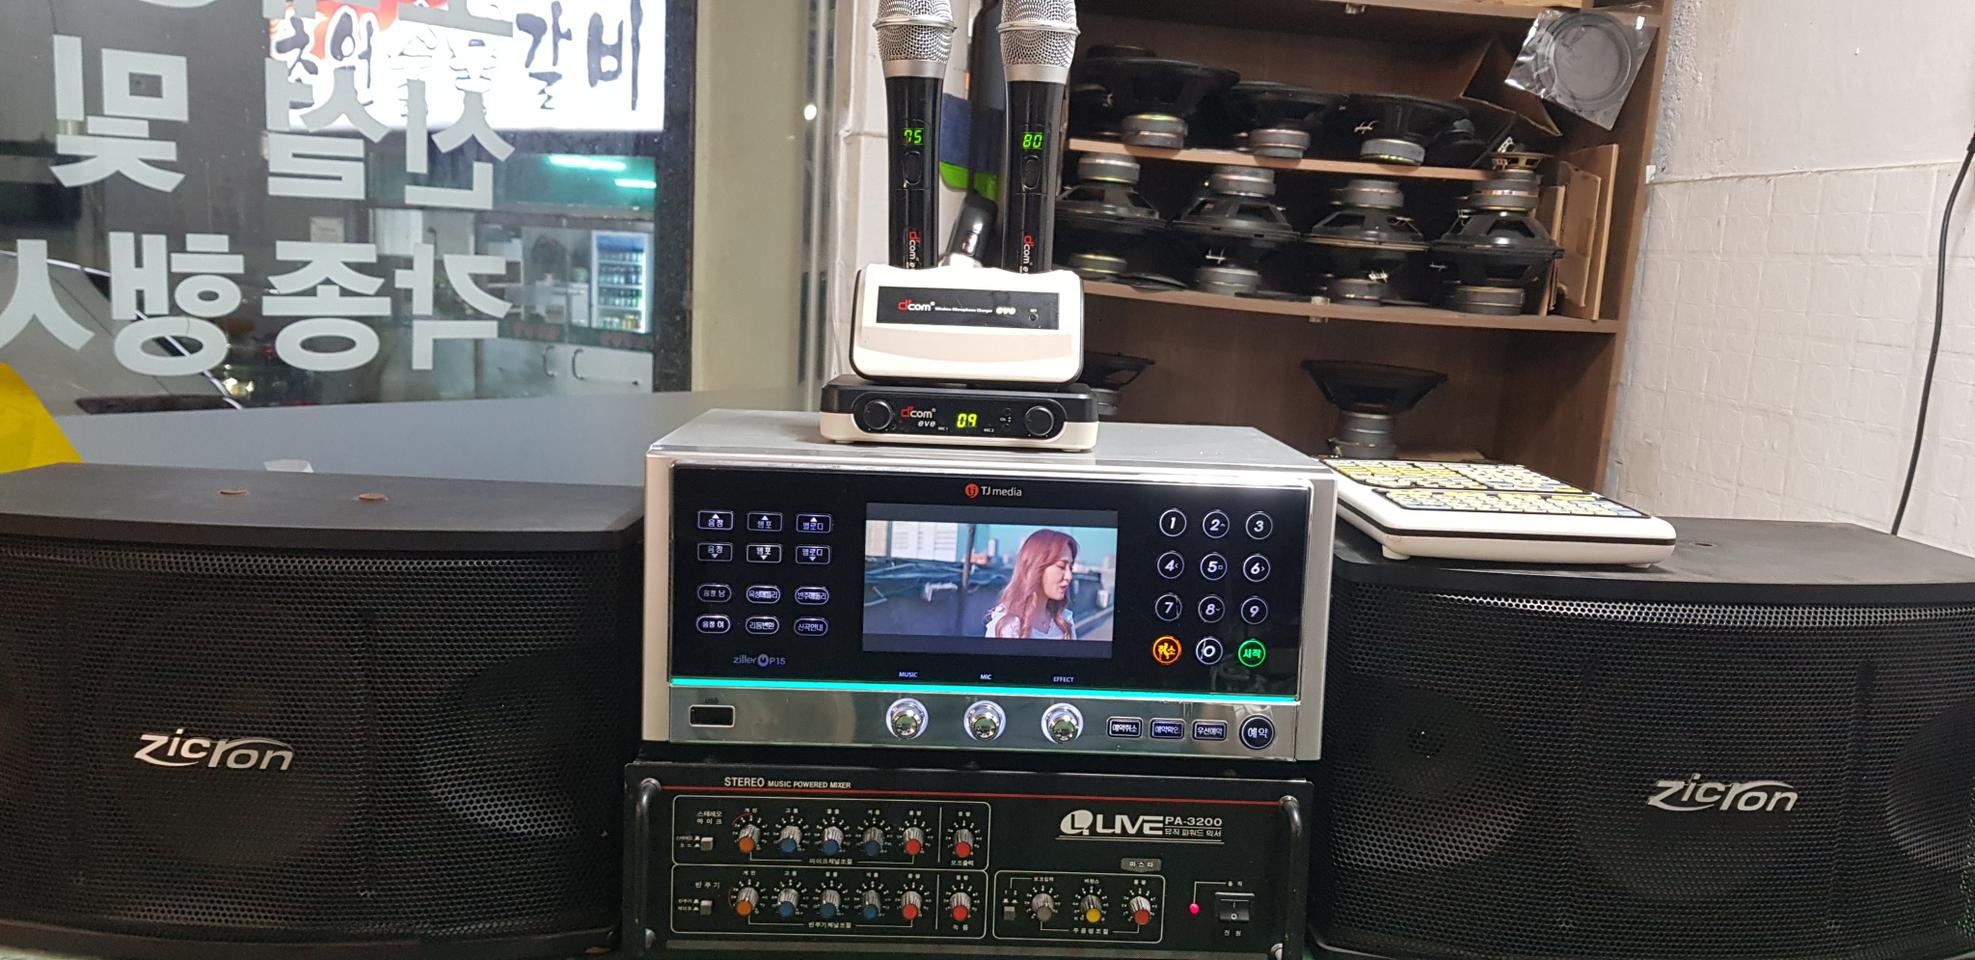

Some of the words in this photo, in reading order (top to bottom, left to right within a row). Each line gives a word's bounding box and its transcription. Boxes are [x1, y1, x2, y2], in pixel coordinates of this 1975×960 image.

[1022, 133, 1043, 148] 80
[956, 413, 978, 429] 09
[992, 486, 1022, 497] media
[1170, 516, 1177, 530] 1
[1209, 518, 1221, 531] 2
[1253, 520, 1264, 533] 3
[1164, 559, 1175, 572] 4
[1207, 560, 1218, 573] 5
[1250, 562, 1260, 575] 6
[1164, 601, 1174, 614] 7
[1204, 603, 1216, 616] 8
[1249, 605, 1260, 618] 9
[1203, 645, 1216, 657] 0
[1243, 648, 1262, 659] 시작
[980, 673, 992, 681] MIC
[1247, 727, 1269, 739] 예약
[724, 776, 765, 787] STEREO
[767, 780, 792, 788] MUSIC
[793, 780, 828, 789] POWERED
[829, 781, 852, 789] MIXER
[1165, 815, 1223, 827] PA-3200
